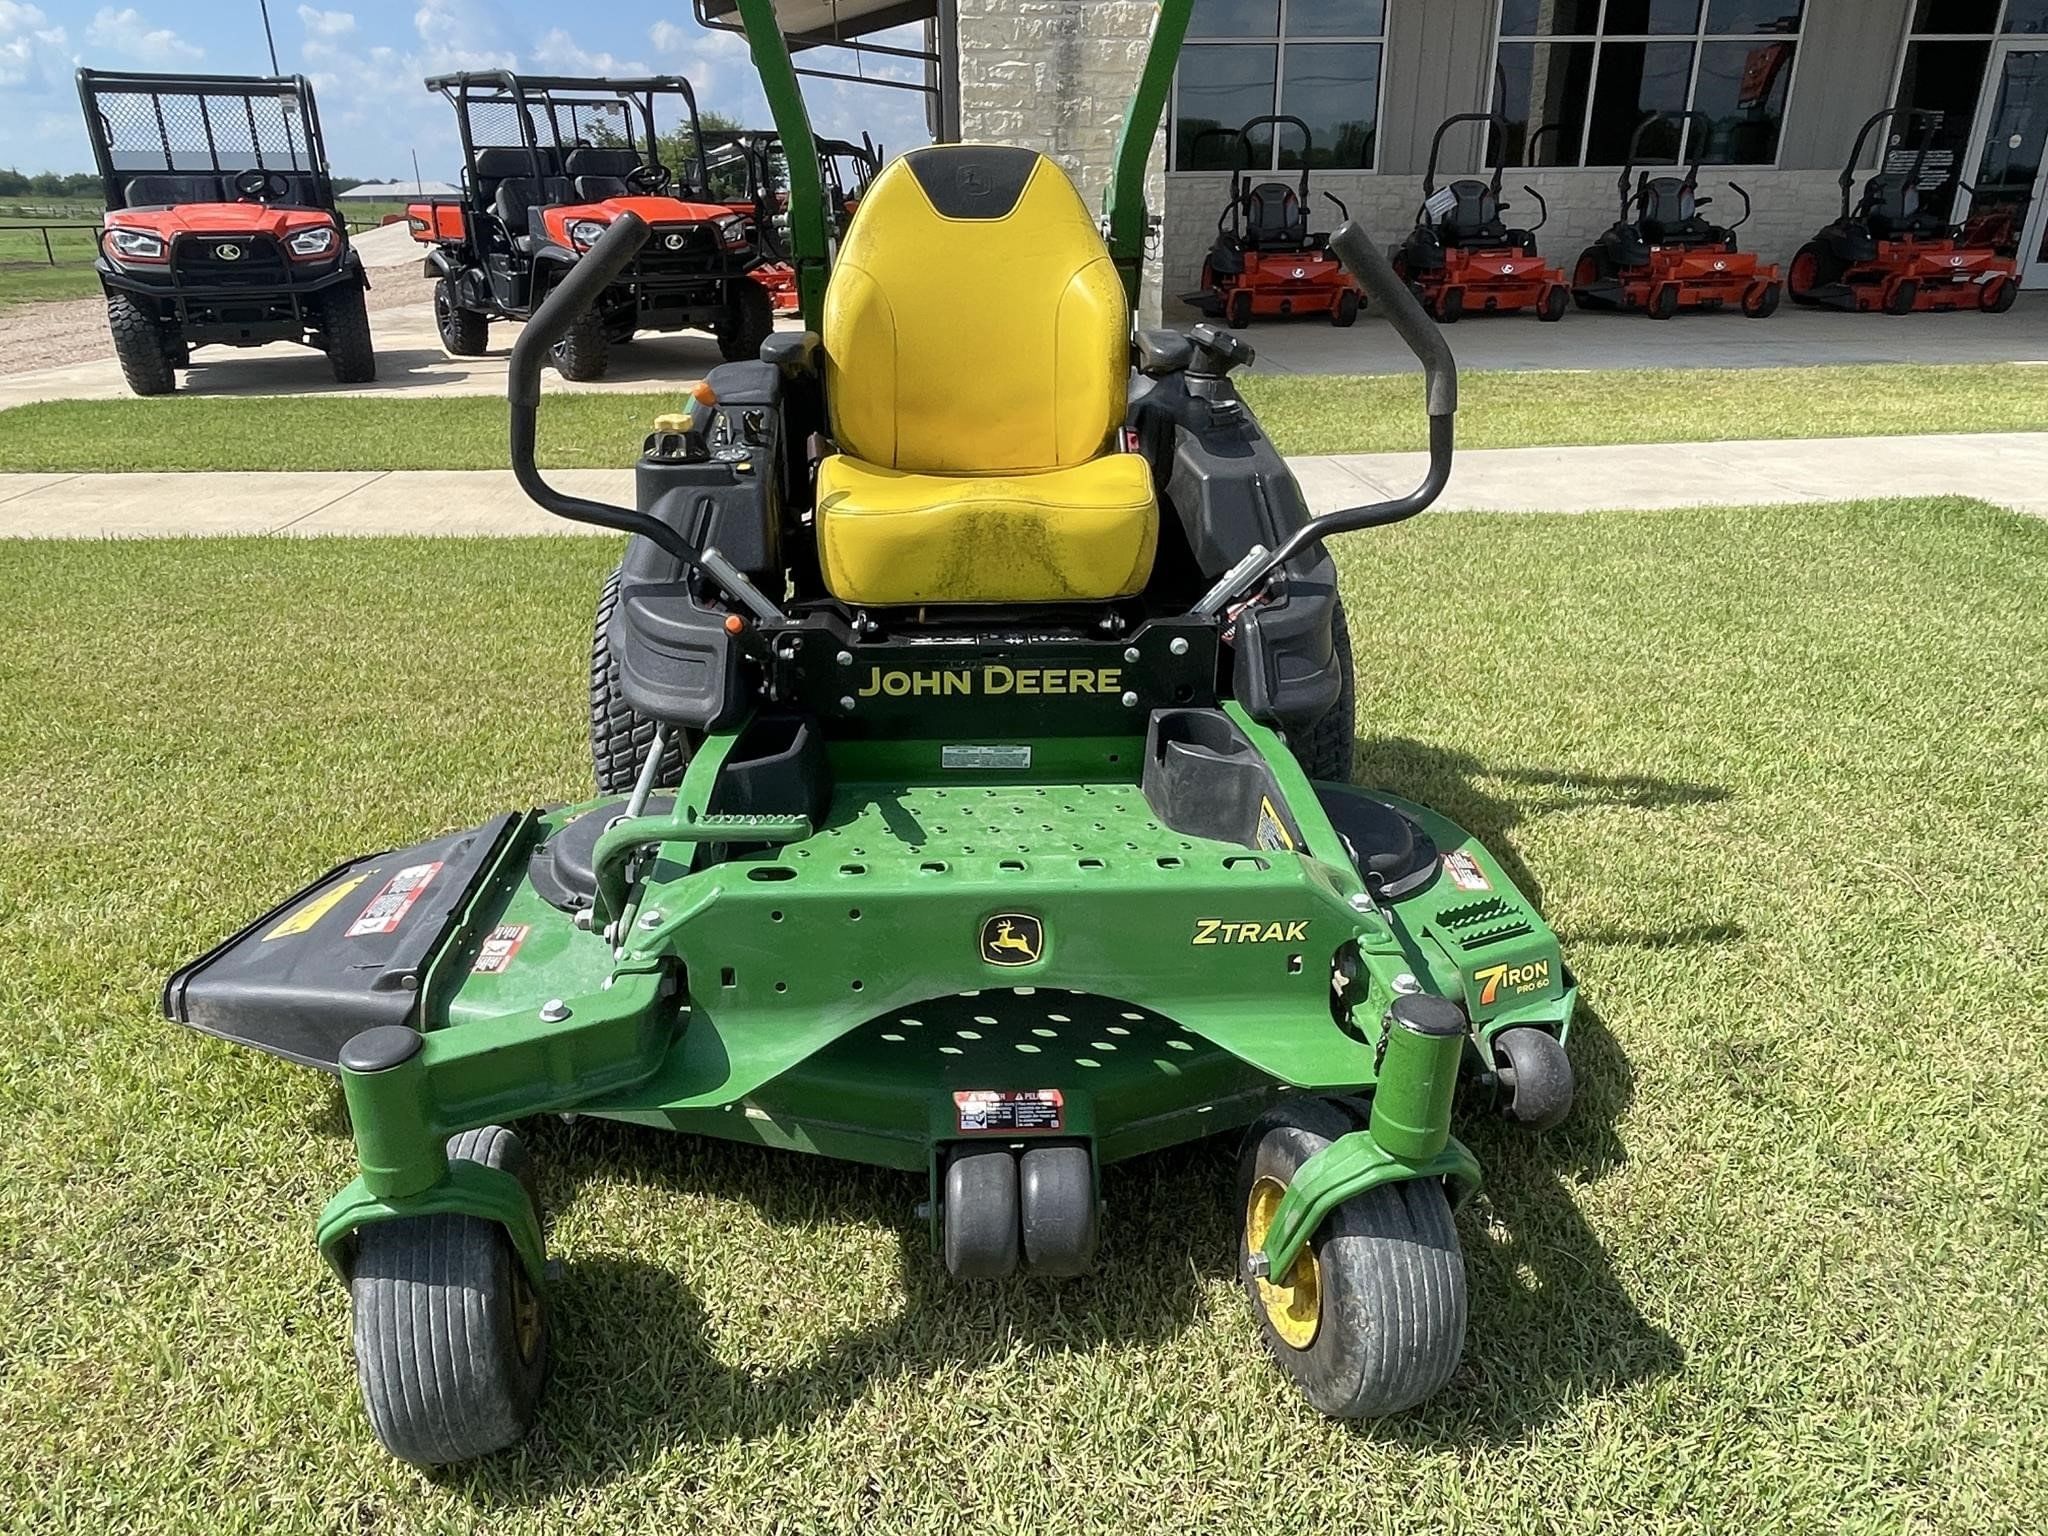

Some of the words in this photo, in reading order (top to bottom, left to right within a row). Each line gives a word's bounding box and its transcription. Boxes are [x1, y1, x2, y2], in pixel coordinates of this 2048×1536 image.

[858, 666, 971, 697] JOHN
[983, 665, 1122, 695] DEERE
[1191, 918, 1310, 945] ZTRAK
[1516, 982, 1536, 995] PRO
[1536, 978, 1550, 989] 60
